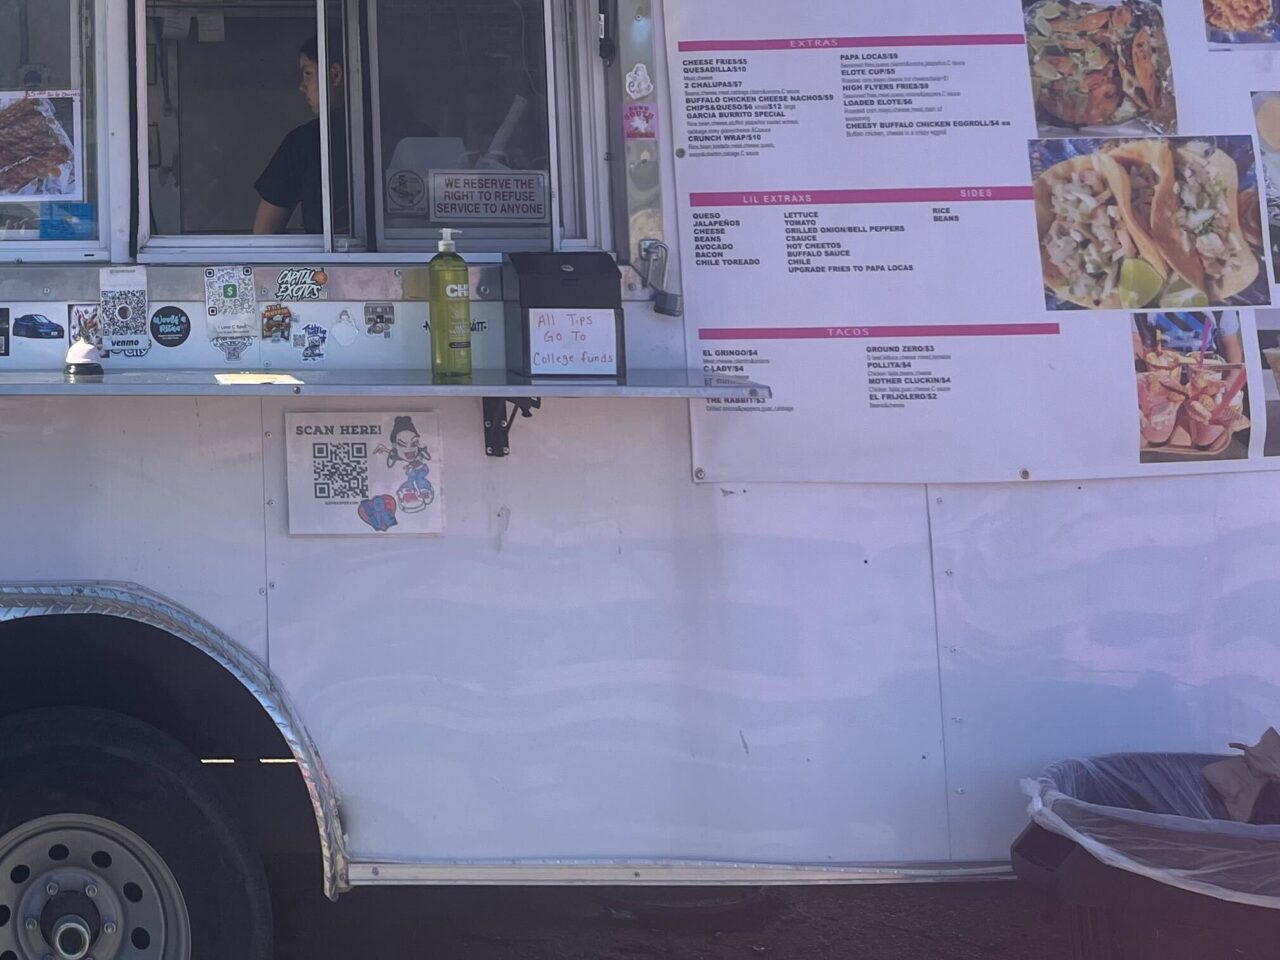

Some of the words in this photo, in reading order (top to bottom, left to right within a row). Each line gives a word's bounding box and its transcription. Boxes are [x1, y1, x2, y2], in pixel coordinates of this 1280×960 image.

[790, 39, 838, 47] EXTRAS
[444, 179, 460, 188] WE
[464, 179, 511, 188] RESERVE
[514, 179, 534, 188] THE
[444, 191, 473, 200] RIGHT
[477, 191, 491, 200] TO
[495, 192, 535, 201] REFUSE
[743, 195, 759, 203] LIL
[764, 194, 812, 203] EXTRAXS
[437, 203, 480, 213] SERVICE
[483, 203, 497, 213] TO
[500, 204, 543, 214] ANYONE
[693, 219, 740, 227] JALAPEÑOS
[277, 268, 317, 286] CAPITAL
[275, 284, 322, 301] EXOTICS
[538, 315, 555, 328] All
[571, 331, 586, 341] To
[828, 328, 869, 336] TACOS
[533, 352, 575, 366] College
[581, 352, 613, 363] funds
[296, 425, 334, 435] SCAN
[340, 425, 381, 435] HERE!
